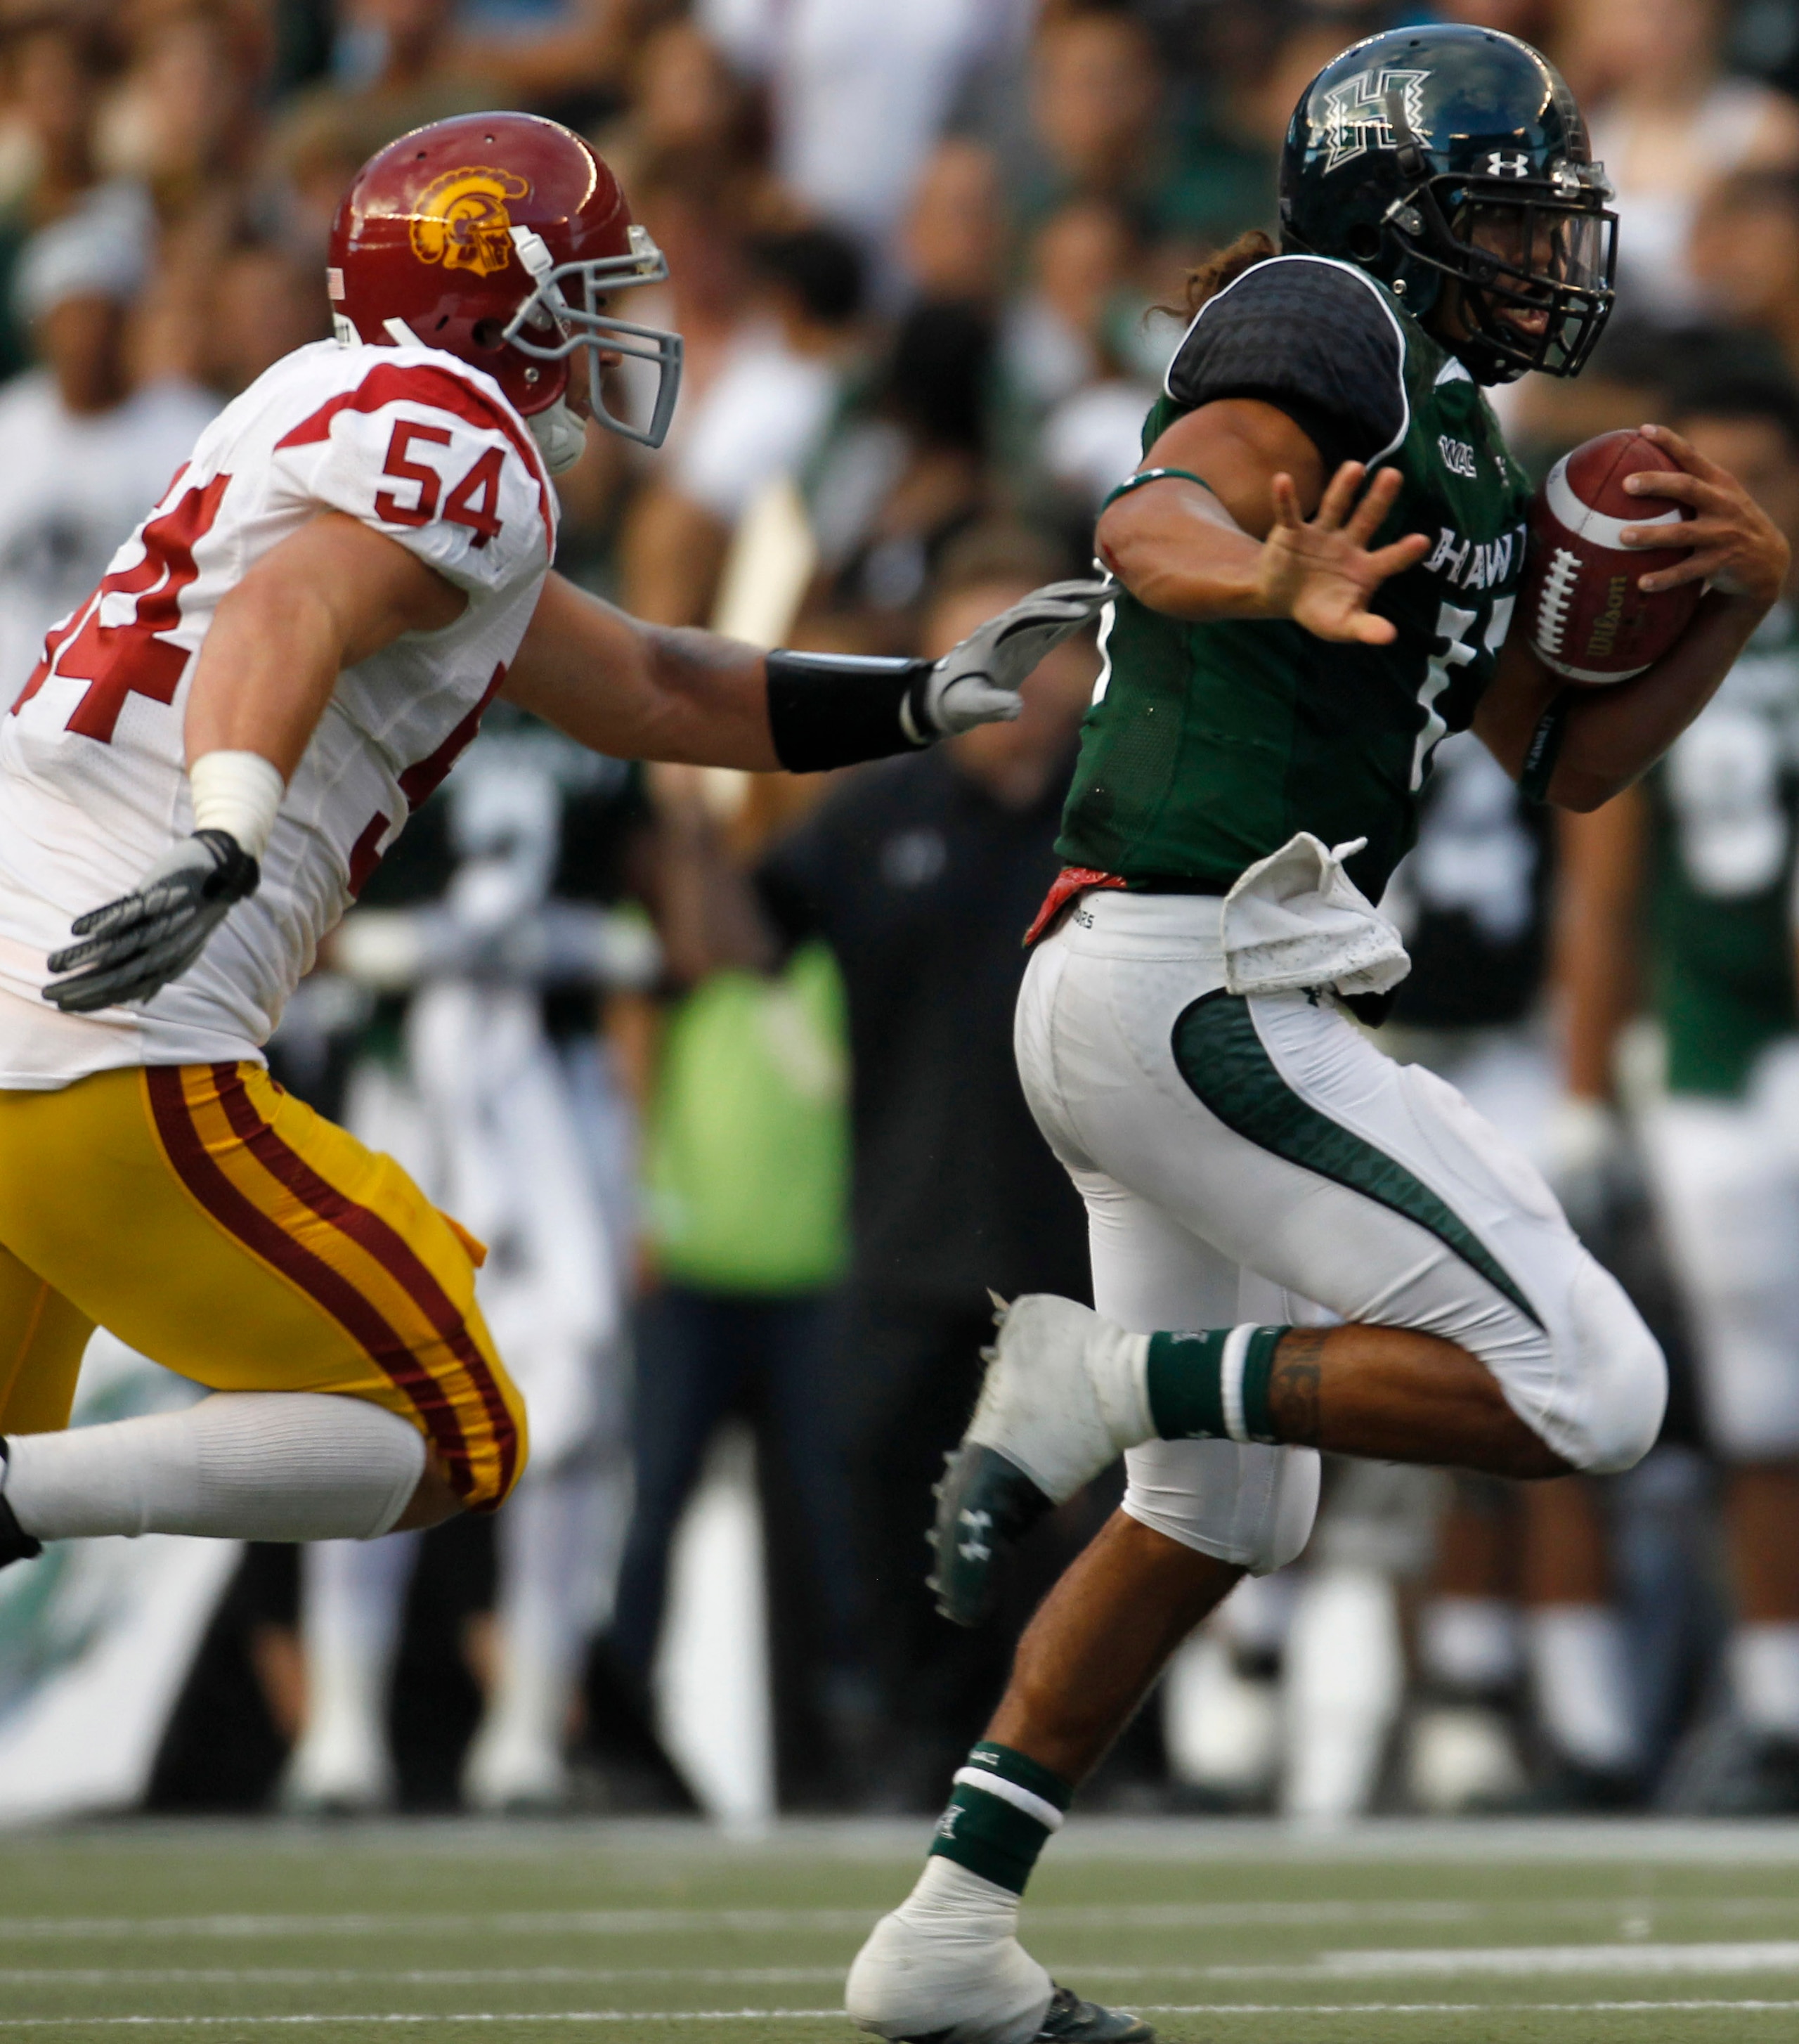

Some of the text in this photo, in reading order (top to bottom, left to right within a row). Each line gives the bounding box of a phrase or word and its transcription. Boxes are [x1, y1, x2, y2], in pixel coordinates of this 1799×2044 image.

[374, 418, 506, 550] 54
[1437, 434, 1477, 478] WAC
[1586, 575, 1627, 656] Wilson
